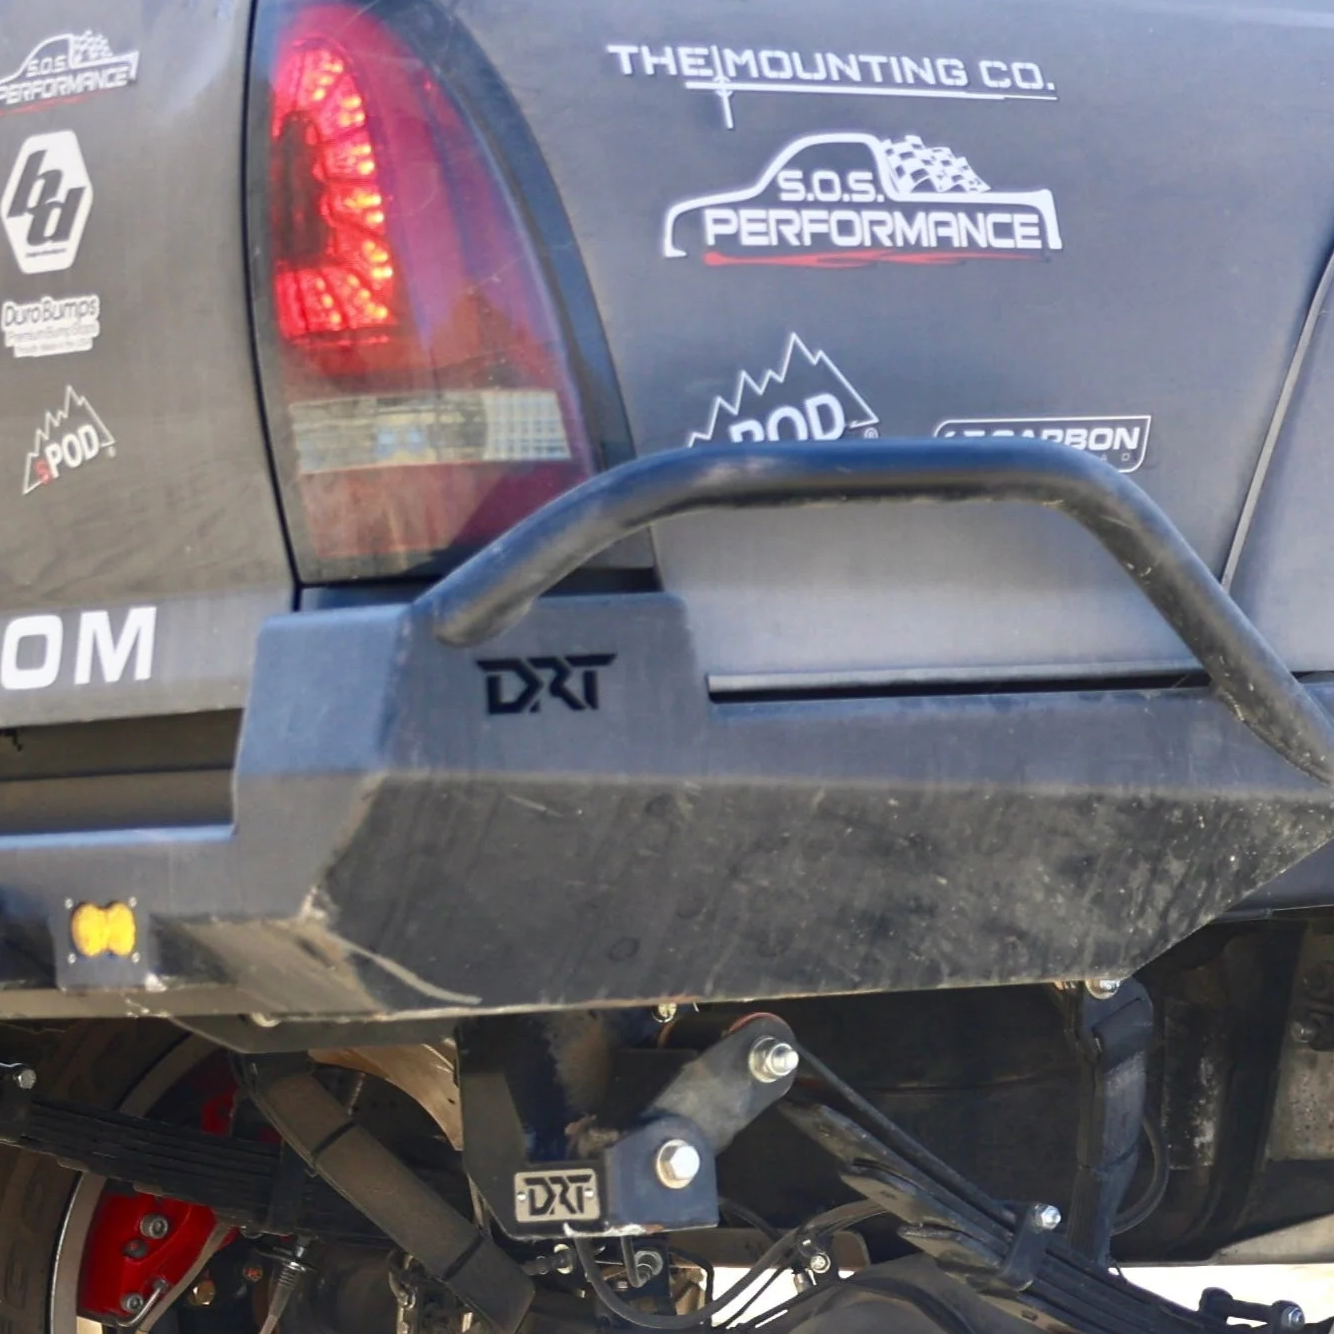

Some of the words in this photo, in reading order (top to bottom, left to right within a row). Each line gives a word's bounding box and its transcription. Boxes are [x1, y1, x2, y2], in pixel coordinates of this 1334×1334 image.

[722, 48, 967, 88] MOUNTING
[978, 59, 1056, 91] CO.
[703, 208, 1044, 250] PERFORMANCE
[475, 653, 618, 715] DRT
[523, 1174, 593, 1217] DRT
